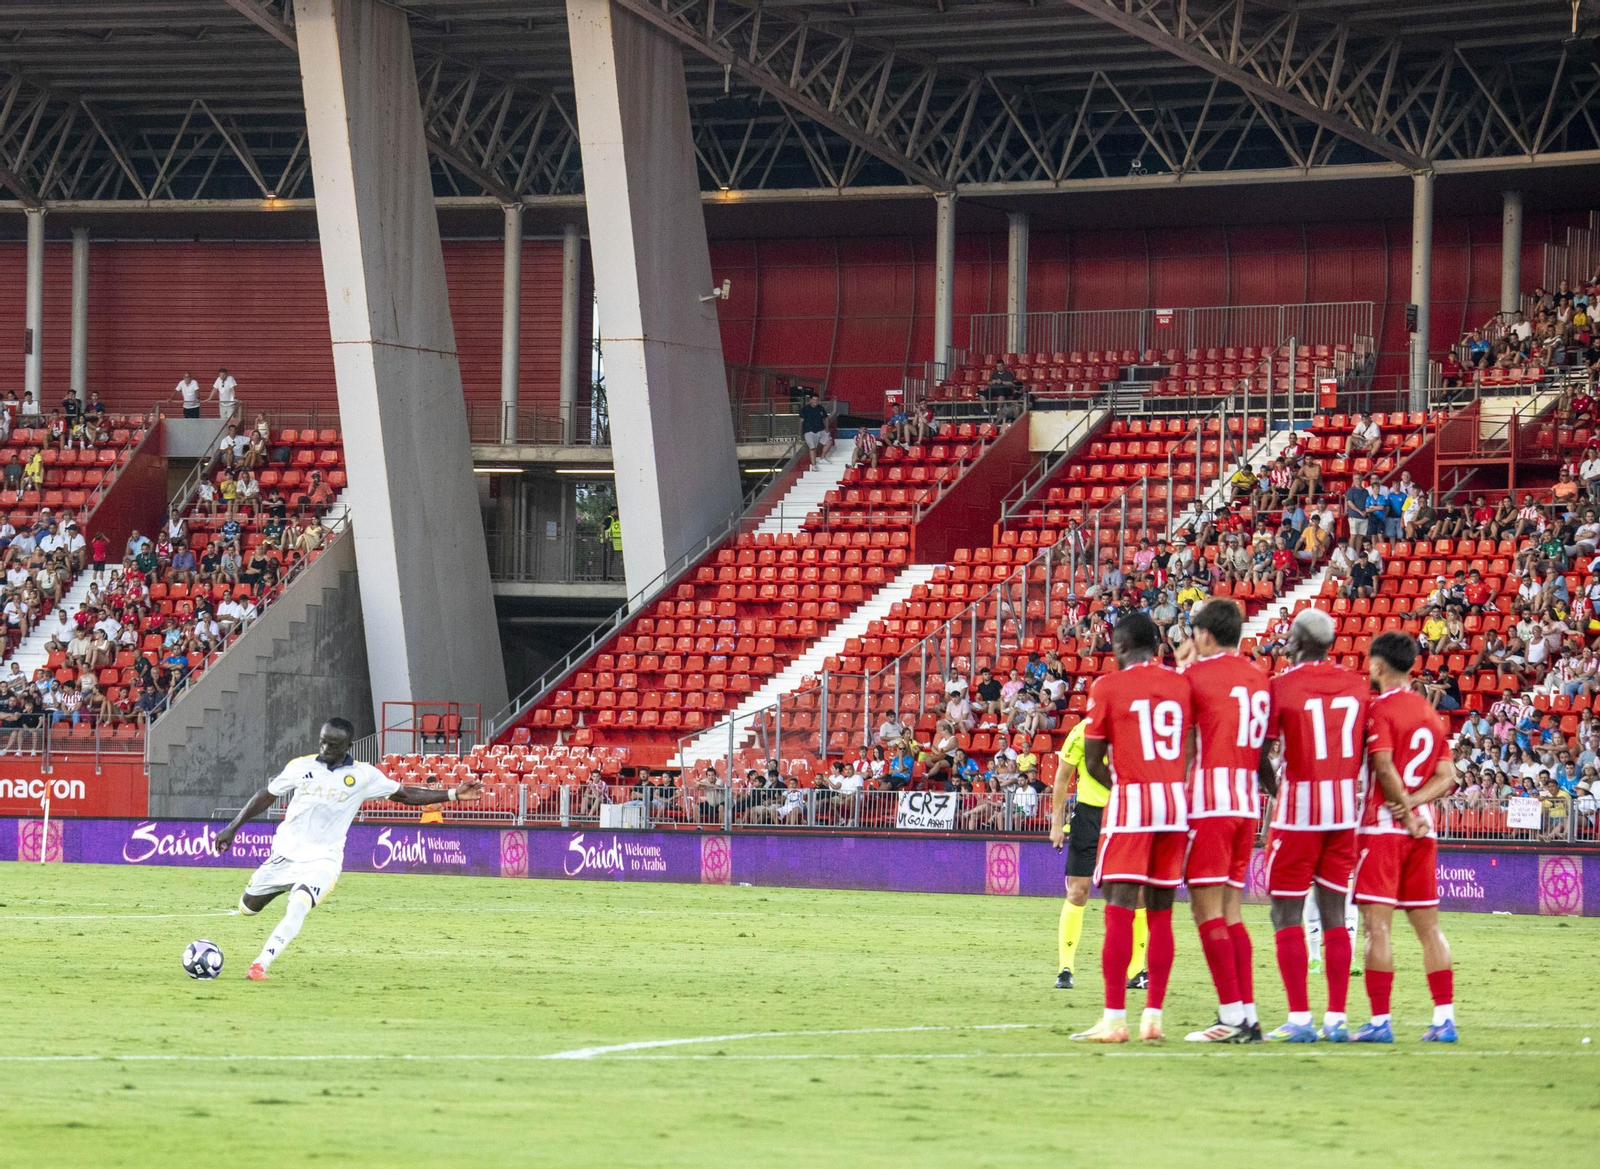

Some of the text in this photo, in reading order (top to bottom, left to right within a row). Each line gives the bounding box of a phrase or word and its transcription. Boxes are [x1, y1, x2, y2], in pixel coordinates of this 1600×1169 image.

[1229, 685, 1271, 749] 18
[1129, 699, 1183, 761] 19
[1304, 696, 1360, 760] 17
[1403, 727, 1434, 787] 2
[909, 792, 950, 817] CR7
[908, 815, 925, 827] GOL
[234, 831, 272, 845] elcom
[427, 837, 462, 851] Welcome
[232, 846, 246, 857] to
[433, 850, 468, 865] to Arabia
[625, 843, 662, 857] Welcome
[631, 857, 667, 872] to Arabia
[1435, 864, 1476, 881] elcome
[1437, 881, 1485, 899] o Arabia
